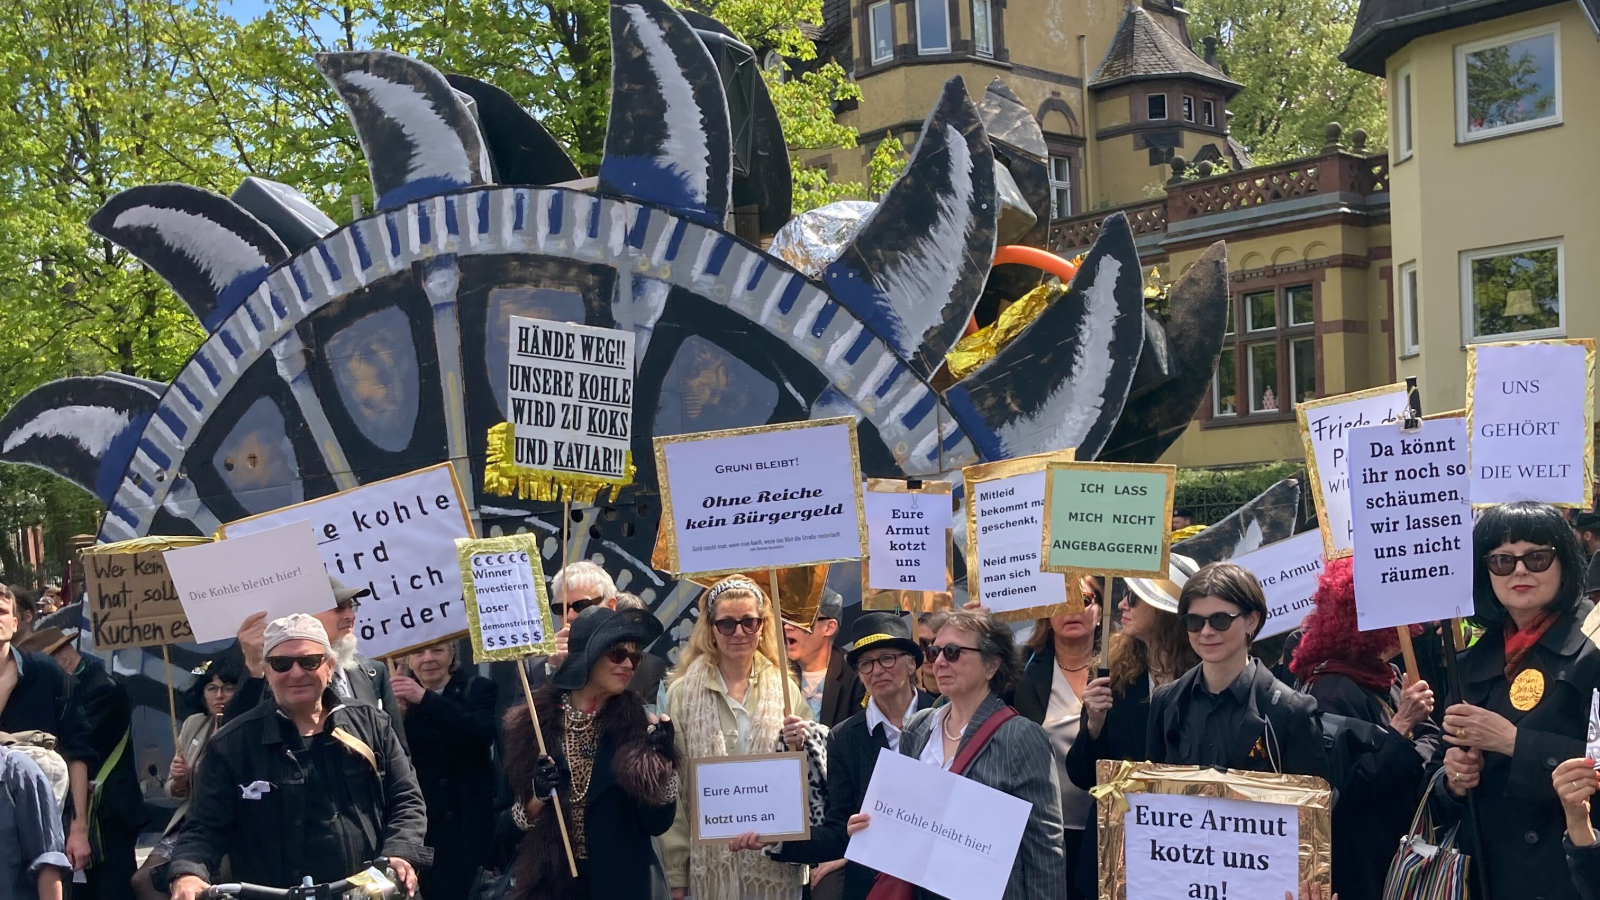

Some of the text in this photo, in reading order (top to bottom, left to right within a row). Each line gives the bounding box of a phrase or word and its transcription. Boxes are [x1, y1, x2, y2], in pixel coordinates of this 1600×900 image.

[517, 325, 626, 367] HÄNDE WEG!!
[509, 364, 631, 406] UNSERE KOHLE
[1502, 380, 1540, 394] UNS
[511, 398, 628, 438] WIRD ZU KOKS
[1481, 420, 1560, 438] GEHÖRT
[514, 436, 624, 474] UND KAVIAR!!
[1370, 436, 1456, 458] Da könnt
[1362, 462, 1466, 484] ihr noch so
[1480, 464, 1570, 480] DIE WELT
[702, 487, 824, 508] Ohne Reiche
[980, 487, 1014, 502] Mitleid
[1080, 483, 1148, 496] ICH LASS
[1366, 489, 1464, 510] schäumen,
[352, 494, 450, 532] kohle
[686, 503, 844, 530] kein Bürgergeld
[892, 508, 924, 519] Eure
[981, 501, 1028, 517] bekommt
[982, 515, 1038, 534] geschenkt,
[1068, 512, 1156, 526] MICH NICHT
[1370, 516, 1400, 534] wir
[1406, 513, 1462, 531] lassen
[886, 524, 930, 535] Armut
[890, 540, 926, 551] kotzt
[1052, 540, 1158, 554] ANGEBAGGERN!
[1374, 536, 1462, 560] uns nicht
[93, 554, 128, 578] Wer
[896, 558, 920, 567] uns
[983, 552, 1037, 568] Neid muss
[473, 568, 512, 580] Winner
[900, 574, 916, 582] an
[984, 568, 1031, 584] man sich
[1280, 560, 1320, 582] Armut
[1381, 564, 1454, 584] räumen.
[189, 566, 302, 601] Die Kohle bleibt hier!
[475, 582, 529, 594] investieren
[985, 584, 1036, 599] verdienen
[479, 604, 510, 614] Loser
[1292, 596, 1316, 610] uns
[93, 610, 164, 646] Kuchen
[482, 618, 540, 631] demonstrieren
[704, 784, 768, 797] Eure Armut
[704, 812, 775, 825] kotzt uns an
[874, 800, 992, 855] Die Kohle bleibt hier!
[1134, 804, 1287, 836] Eure Armut
[1150, 839, 1270, 870] kotzt uns
[1188, 881, 1227, 900] an!
